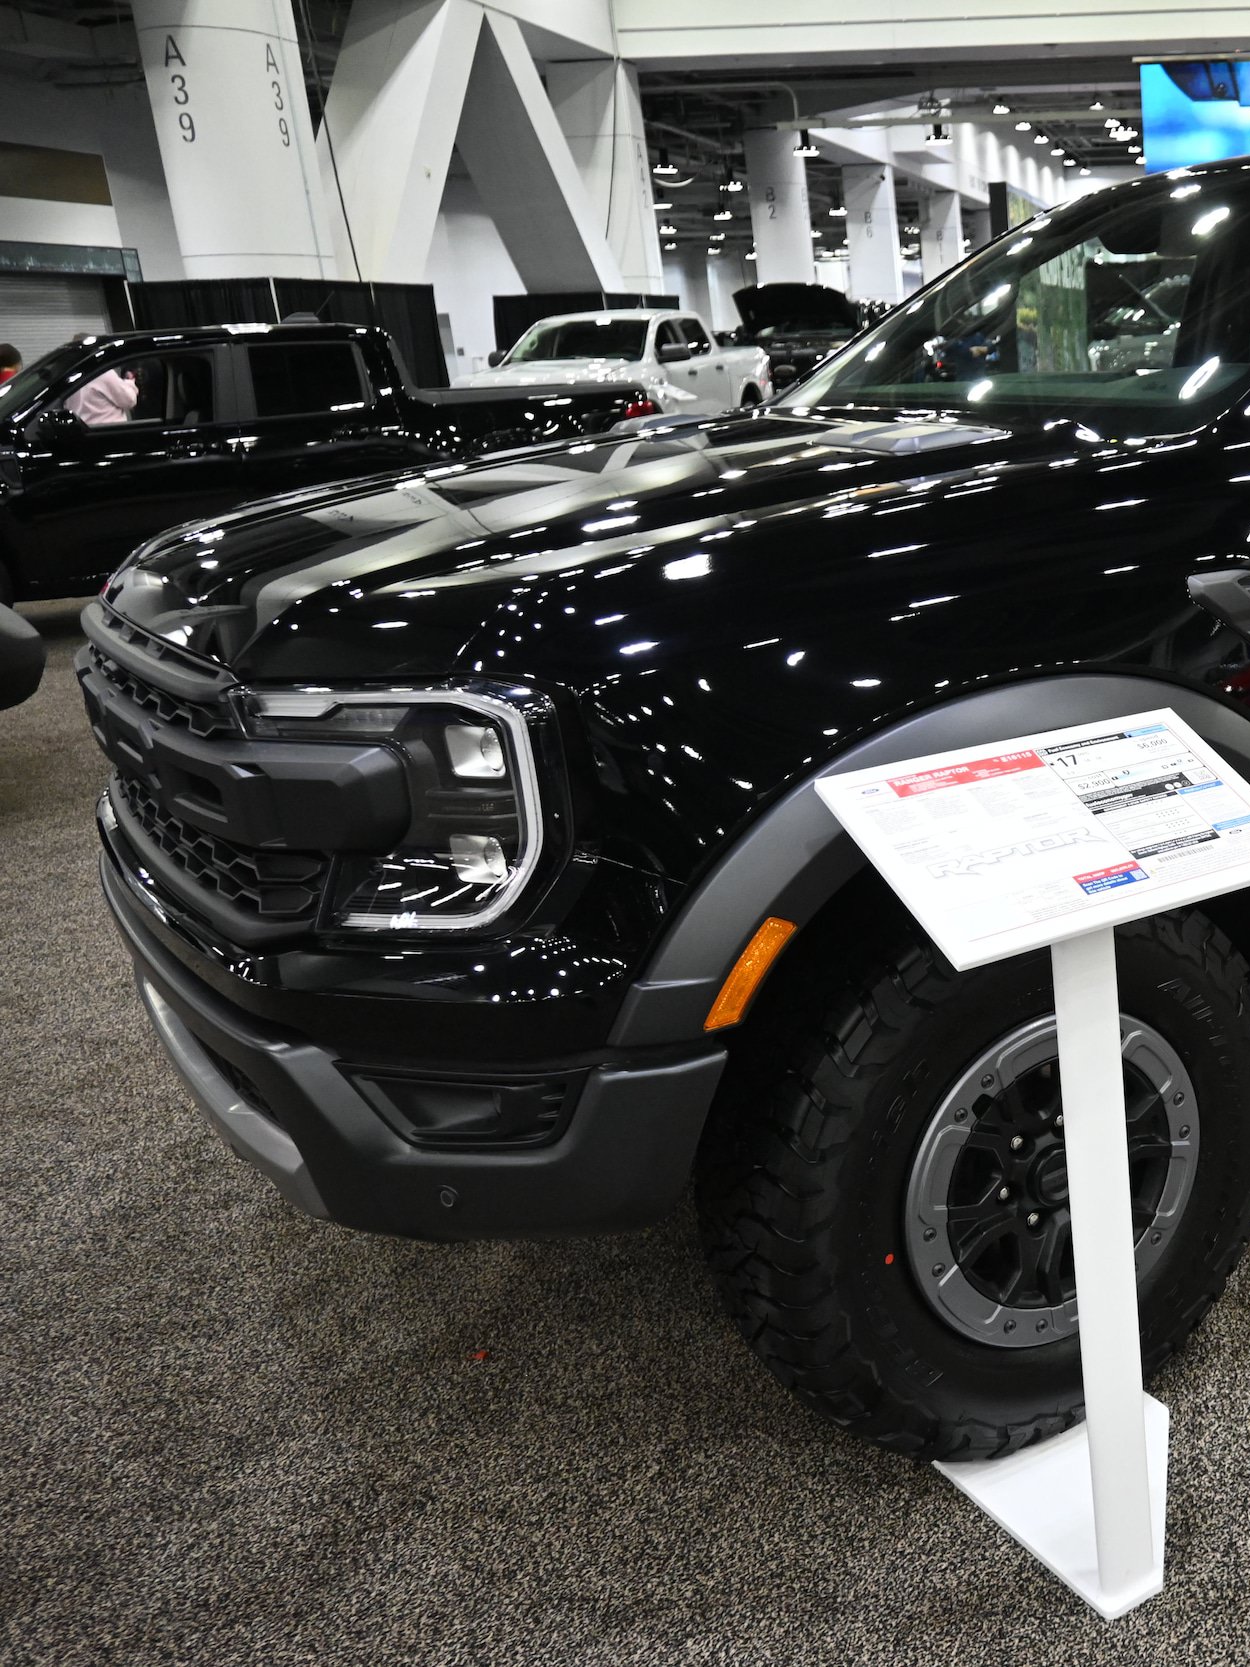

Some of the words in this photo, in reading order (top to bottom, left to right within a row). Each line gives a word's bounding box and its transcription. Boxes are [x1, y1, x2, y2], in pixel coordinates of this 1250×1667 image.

[1056, 754, 1077, 767] 17
[893, 773, 933, 788] RANGER
[933, 765, 970, 780] RAPTOR
[1078, 778, 1110, 790] $2,900
[925, 826, 1109, 879] RAPTOR
